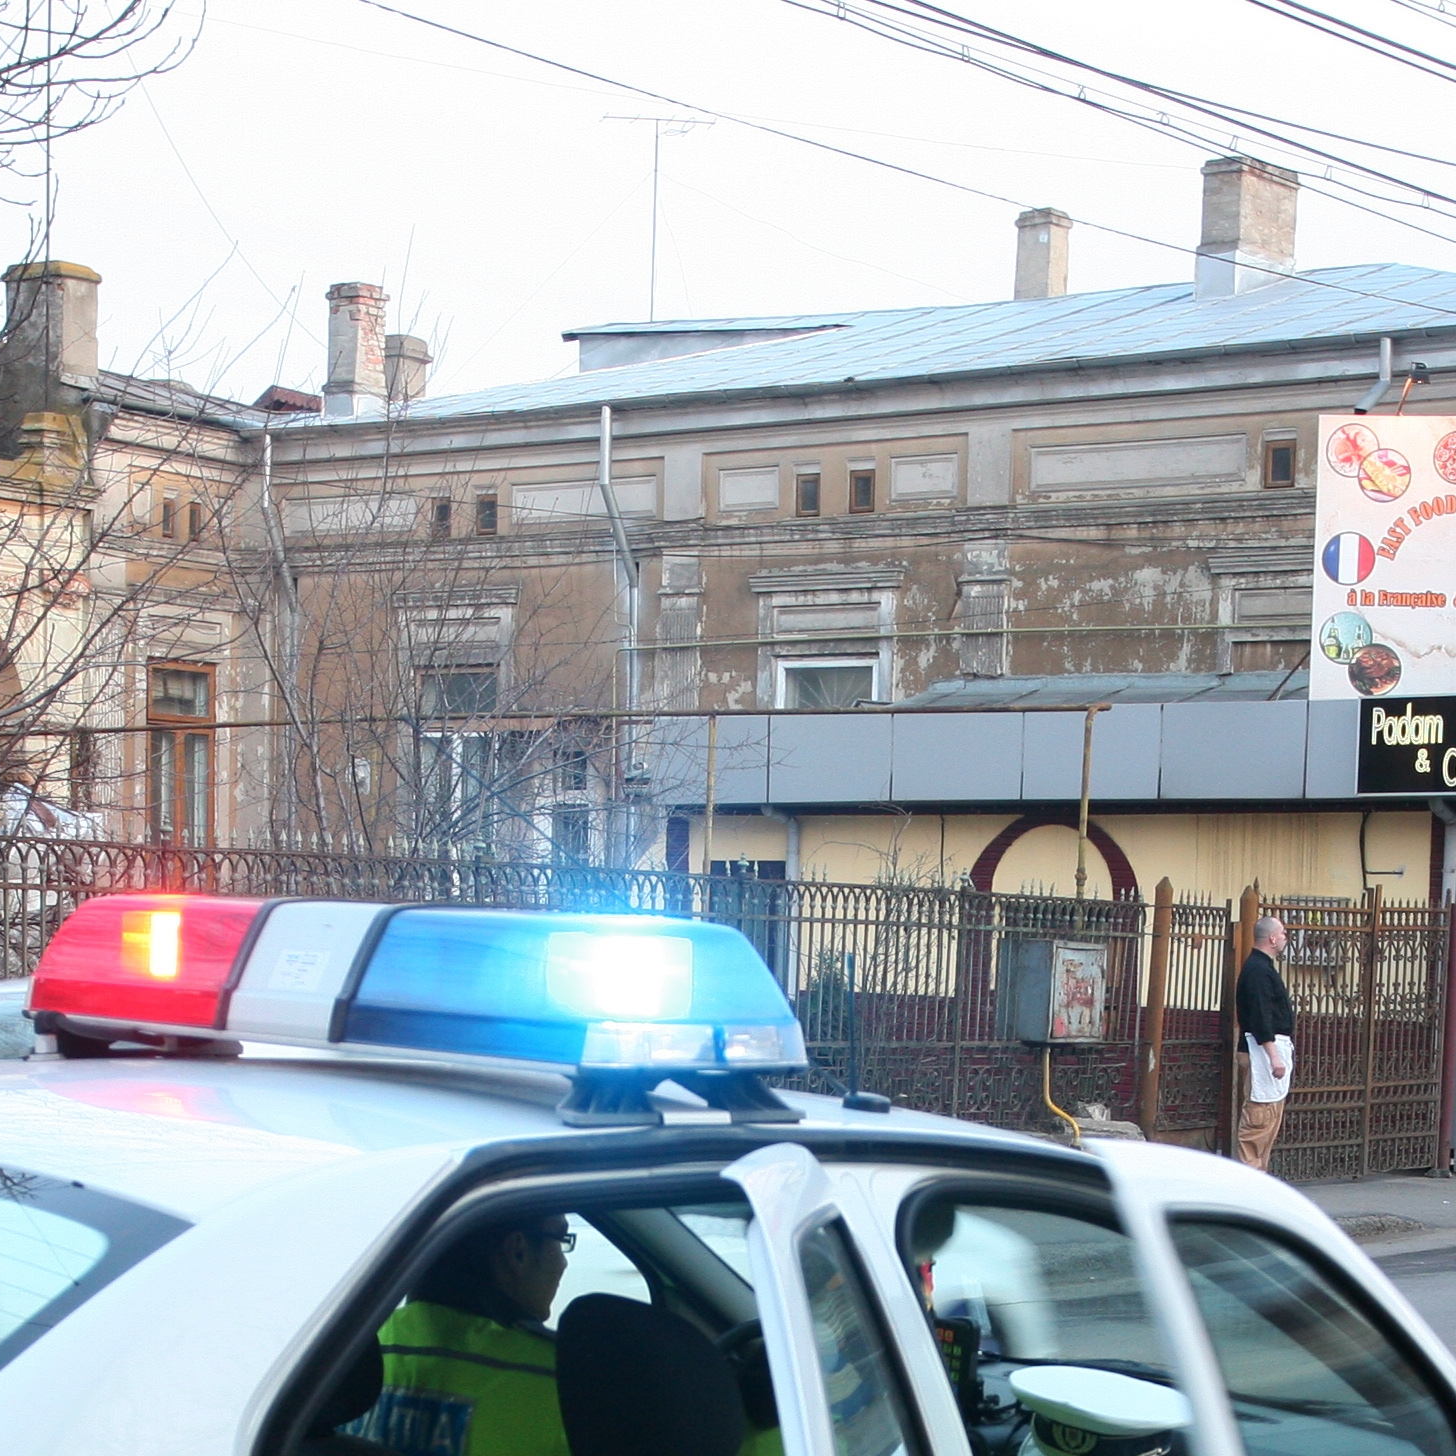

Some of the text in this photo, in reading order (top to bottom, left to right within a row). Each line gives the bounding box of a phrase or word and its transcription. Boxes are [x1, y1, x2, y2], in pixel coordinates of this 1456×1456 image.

[1375, 516, 1412, 561] FAST
[1360, 589, 1374, 606] la
[1378, 590, 1446, 609] Française
[1371, 702, 1444, 746] Padam
[1414, 748, 1431, 774] &
